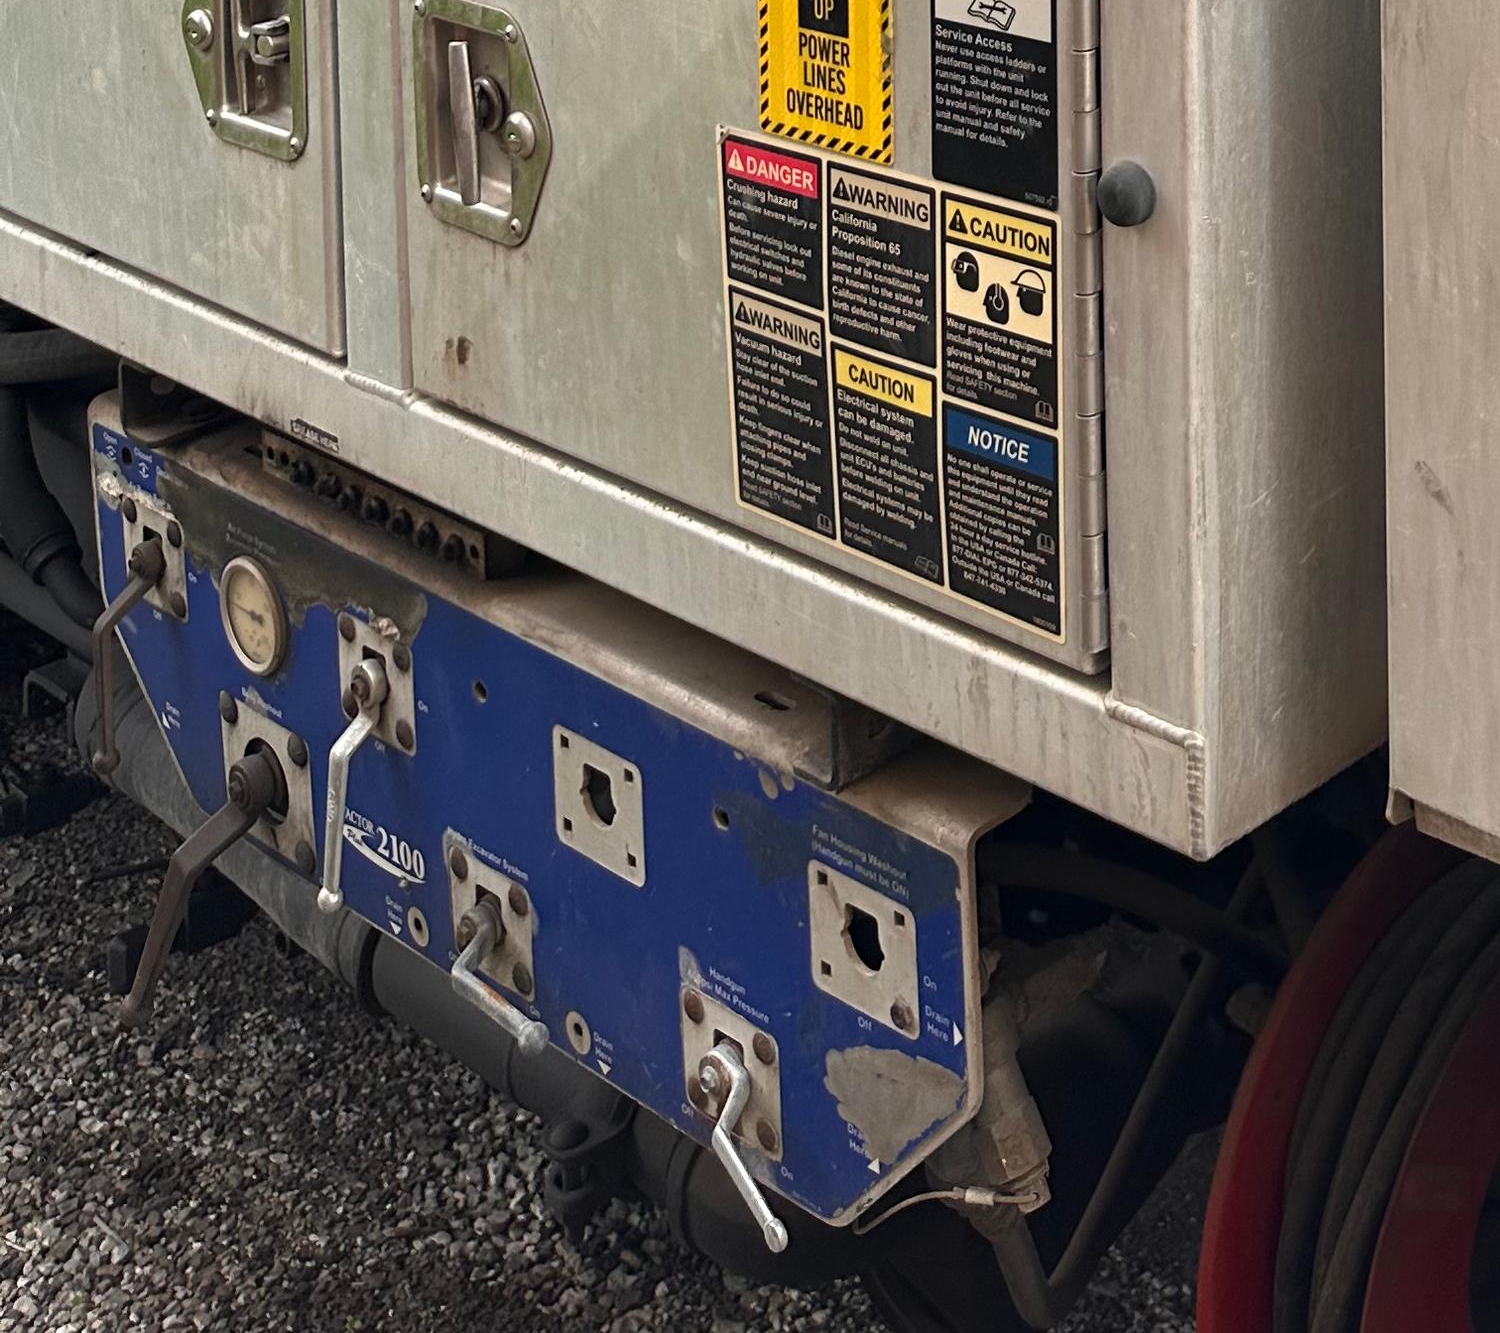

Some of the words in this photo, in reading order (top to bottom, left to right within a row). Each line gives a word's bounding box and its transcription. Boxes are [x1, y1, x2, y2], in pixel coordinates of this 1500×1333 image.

[799, 32, 850, 68] POWER
[935, 23, 972, 44] Service
[975, 32, 1012, 52] Access
[803, 65, 847, 96] LINES
[786, 88, 864, 130] OVERHEAD
[745, 154, 813, 191] DANGER
[726, 177, 765, 203] Crushing
[767, 189, 798, 210] hazard
[848, 183, 928, 223] WARNING
[831, 208, 877, 232] California
[970, 216, 1049, 257] CAUTION
[831, 225, 886, 254] Proposition
[888, 241, 900, 256] 65
[749, 308, 819, 349] WARNING
[735, 331, 769, 354] Vacuum
[771, 344, 801, 366] hazard
[848, 363, 913, 403] CAUTION
[837, 388, 878, 414] Electrical
[880, 406, 913, 429] system
[838, 406, 853, 420] can
[856, 412, 867, 426] be
[967, 424, 1029, 464] NOTICE
[345, 806, 375, 834] ACTOR
[377, 826, 425, 880] 2100
[923, 975, 937, 992] On
